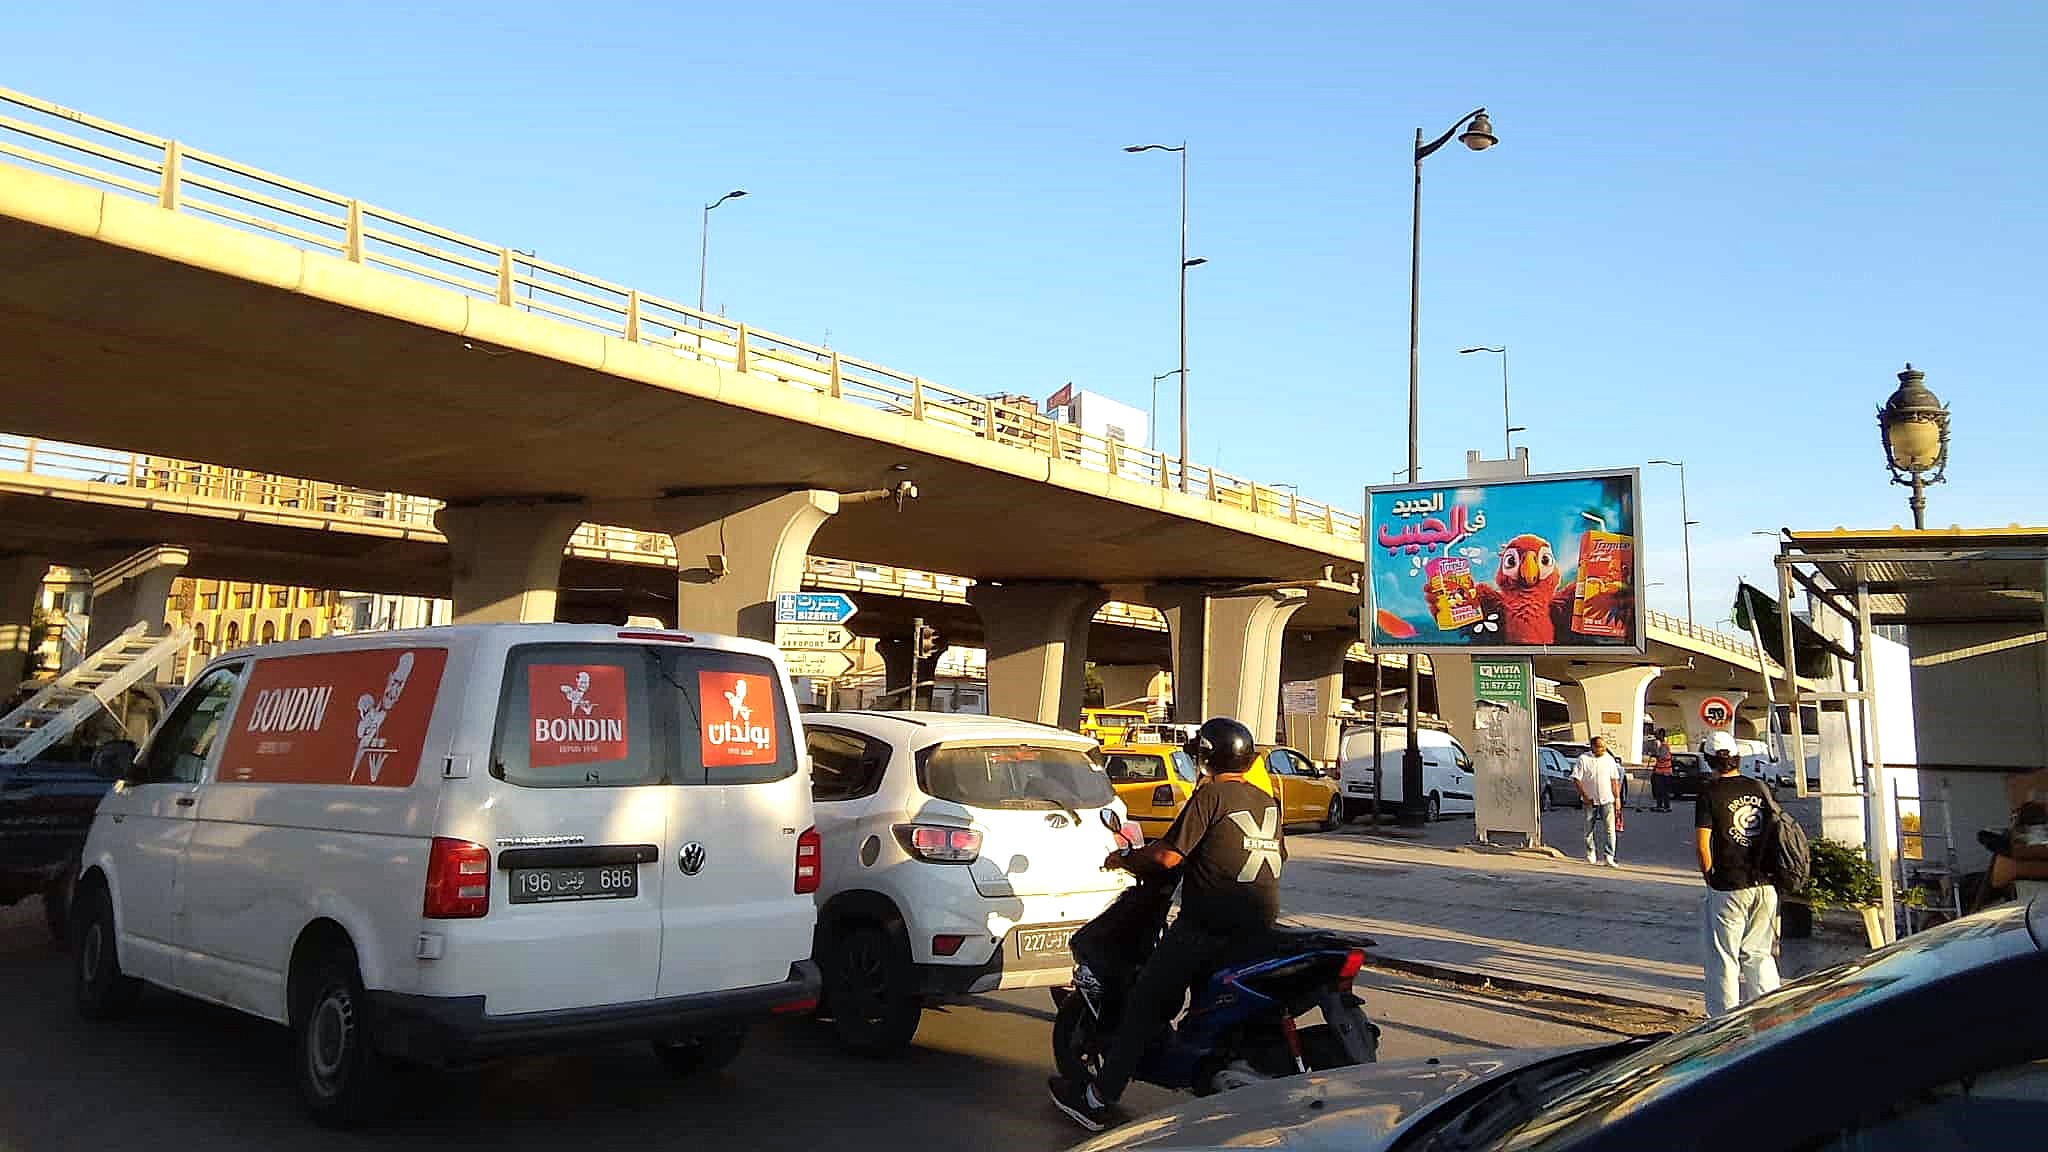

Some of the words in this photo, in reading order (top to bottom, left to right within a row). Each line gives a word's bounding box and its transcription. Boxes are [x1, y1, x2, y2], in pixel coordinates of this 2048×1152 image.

[1392, 492, 1443, 517] الجديد
[1378, 504, 1467, 555] الجيب
[798, 611, 838, 621] BIZERTE
[782, 640, 825, 648] AEROPORT
[1493, 665, 1520, 674] VISTA
[247, 686, 333, 733] BONDIN
[535, 718, 622, 742] BONDIN
[708, 720, 770, 750] بوندان
[519, 873, 553, 893] 196
[599, 870, 632, 889] 686
[1024, 934, 1046, 952] 227
